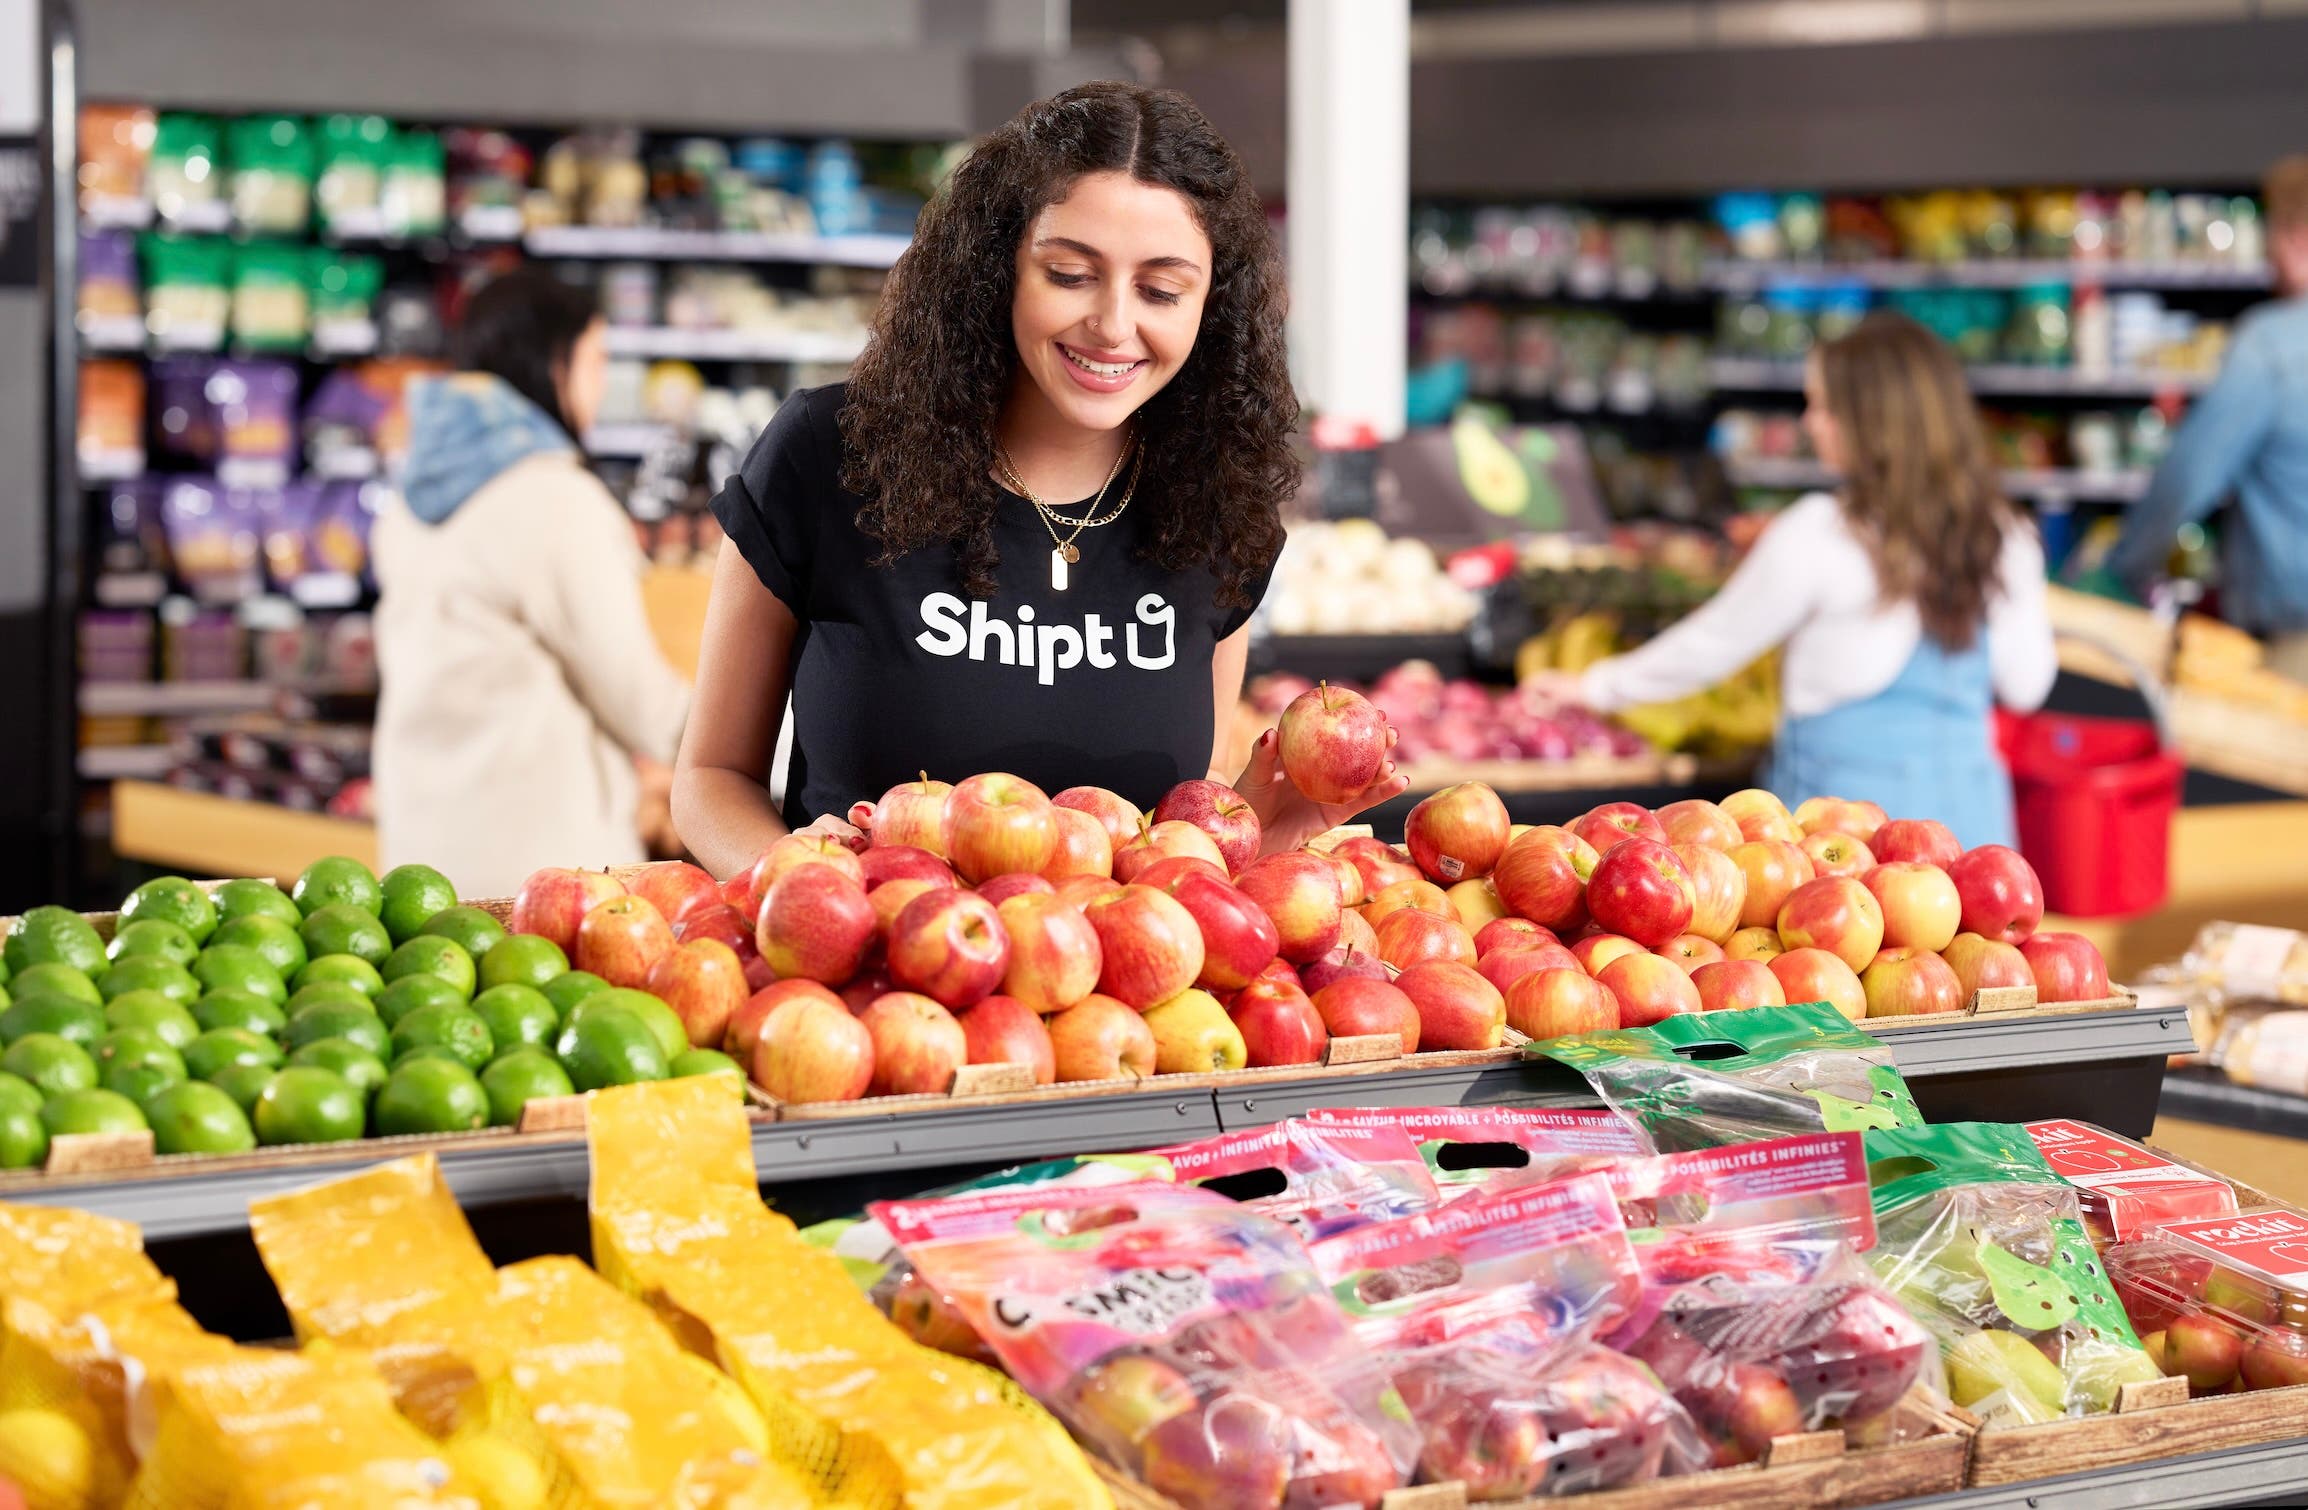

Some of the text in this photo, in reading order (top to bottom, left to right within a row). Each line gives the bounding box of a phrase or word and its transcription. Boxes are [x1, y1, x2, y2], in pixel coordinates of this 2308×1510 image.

[914, 591, 1118, 686] Shipt
[1399, 1114, 1479, 1128] INCROYABLE
[1495, 1113, 1575, 1127] POSSIBILITÉS
[1173, 1149, 1209, 1169] AVOR
[1670, 1149, 1767, 1179] POSSIBILITÉS
[2190, 1217, 2305, 1242] rockit
